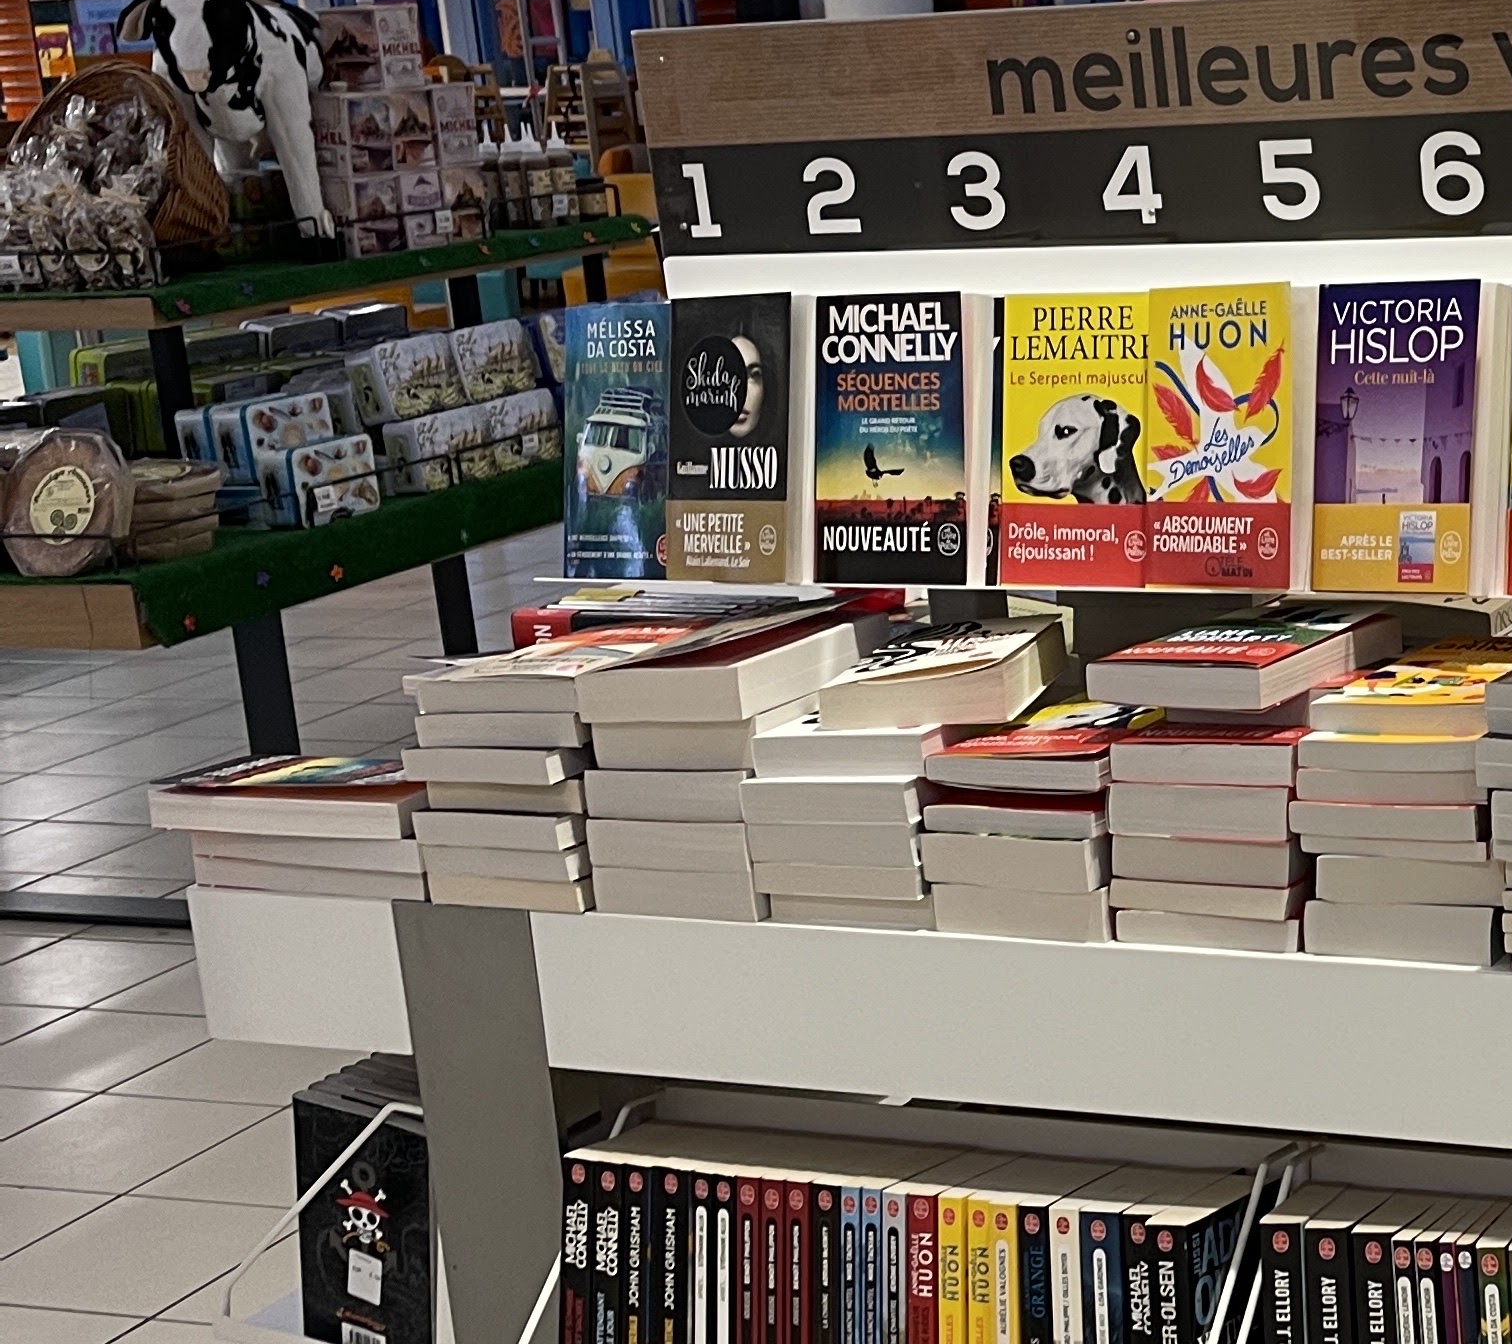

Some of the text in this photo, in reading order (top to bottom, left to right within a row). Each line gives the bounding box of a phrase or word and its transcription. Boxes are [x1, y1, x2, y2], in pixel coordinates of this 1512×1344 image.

[988, 25, 1472, 115] meilleures
[681, 162, 722, 238] 1
[803, 156, 862, 235] 2
[947, 151, 1006, 229] 3
[1102, 145, 1164, 224] 4
[1259, 138, 1322, 221] 5
[1419, 130, 1486, 216] 6
[829, 302, 949, 334] MICHAEL
[1033, 306, 1134, 331] PIERRE
[1170, 298, 1267, 320] ANNE-GAËLLE
[1333, 297, 1463, 326] VICTORIA
[587, 318, 655, 339] MÉLISSA
[1169, 318, 1267, 352] HUON
[587, 340, 656, 358] DA COSTA
[822, 331, 957, 364] CONNELLY
[1331, 325, 1464, 365] HISLOP
[837, 369, 940, 393] SÉQUENCES
[1010, 370, 1148, 388] Le Serpent majuscul
[1354, 368, 1435, 385] Cette nuit-là
[838, 393, 940, 412] MORTELLES
[1204, 417, 1228, 449] Les
[709, 446, 777, 490] MUSSO
[1168, 435, 1254, 487] Demoiselles
[683, 513, 744, 532] UNE PETITE
[1008, 523, 1119, 544] Drôle, immoral,
[1162, 516, 1253, 534] ABSOLUMENT
[684, 534, 742, 553] MERVEILLE
[823, 521, 931, 551] NOUVEAUTÉ
[1153, 535, 1237, 553] FORMIDABLE
[1340, 533, 1392, 547] APRÈS LE
[1008, 544, 1087, 563] réjouissant
[1321, 548, 1392, 561] BEST-SELLER
[629, 1206, 641, 1307] JOHN GRISHAM
[918, 1232, 932, 1297] HUON
[1275, 1270, 1291, 1319] ELLORY
